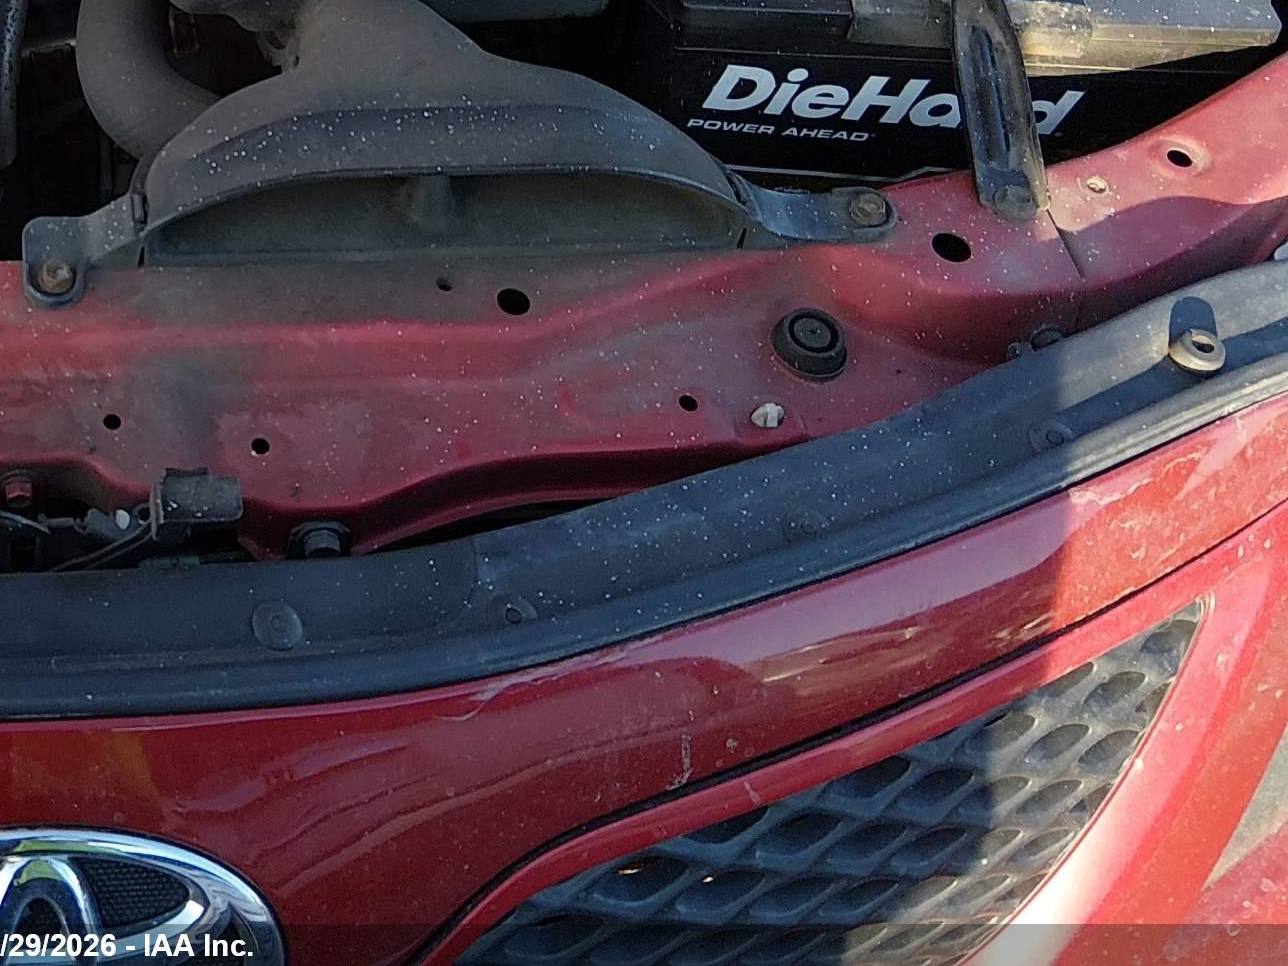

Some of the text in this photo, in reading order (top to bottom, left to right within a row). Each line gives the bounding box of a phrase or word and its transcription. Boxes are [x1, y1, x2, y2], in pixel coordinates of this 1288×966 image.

[702, 64, 1085, 135] DieHad
[686, 119, 871, 142] POWER AHEAD
